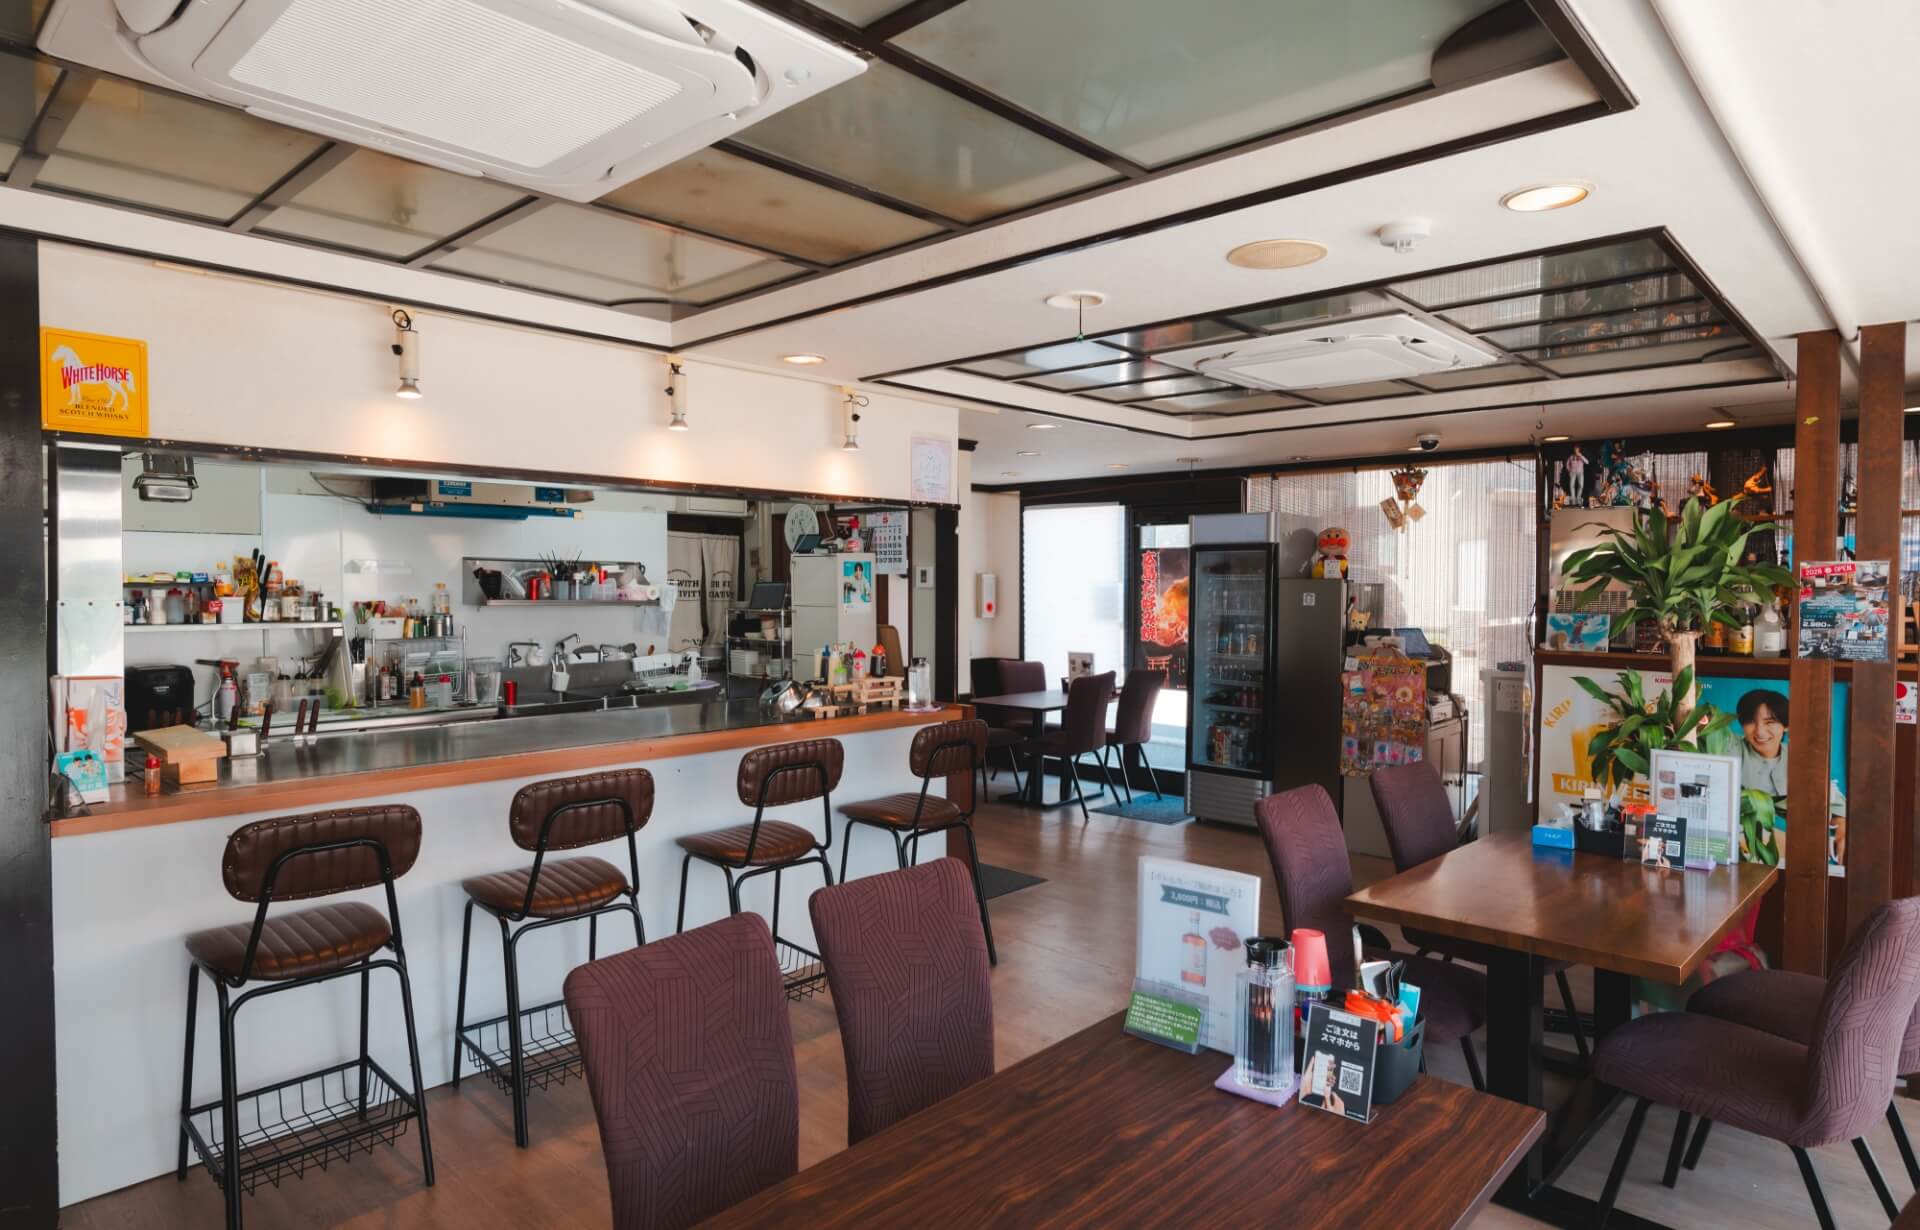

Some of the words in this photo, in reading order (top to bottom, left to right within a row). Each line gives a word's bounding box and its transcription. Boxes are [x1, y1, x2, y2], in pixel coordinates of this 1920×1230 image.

[61, 365, 95, 390] WHITE
[95, 363, 129, 383] HORSE
[1325, 1023, 1358, 1040] ご注文は
[1320, 1032, 1361, 1051] スマホから
